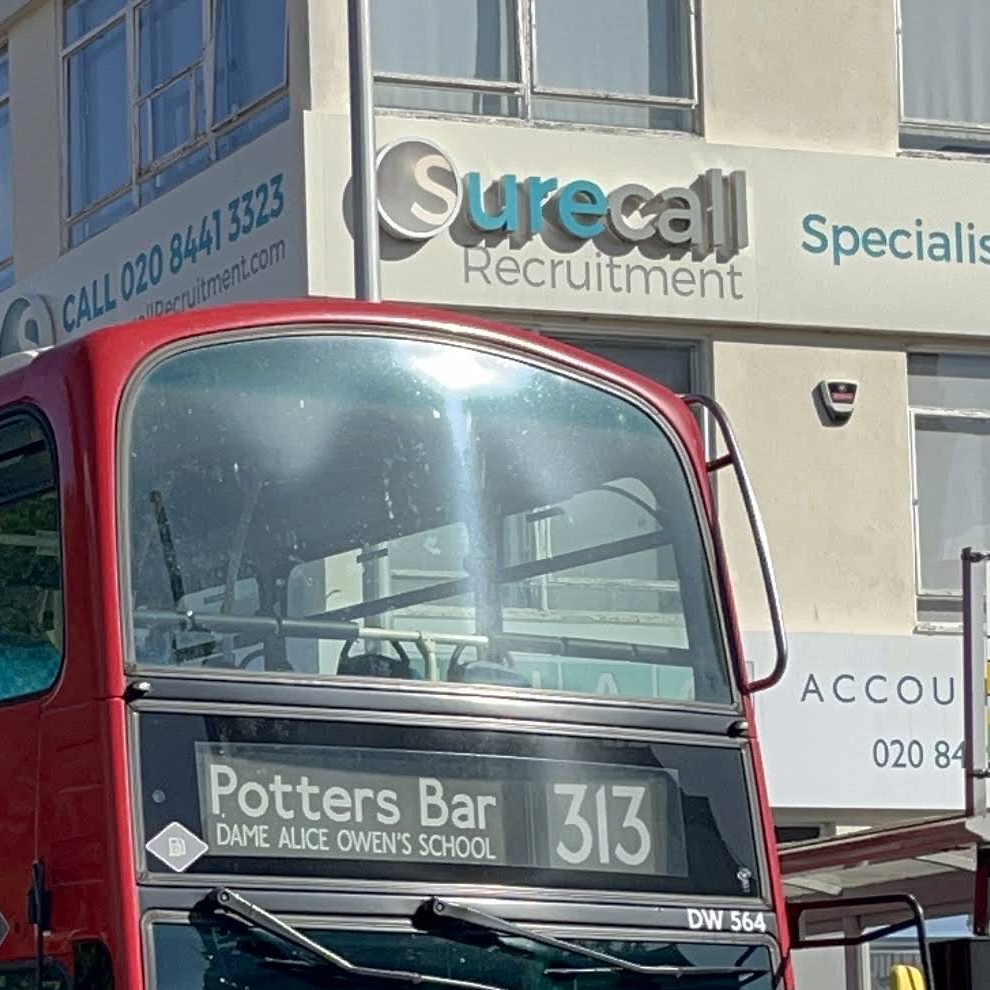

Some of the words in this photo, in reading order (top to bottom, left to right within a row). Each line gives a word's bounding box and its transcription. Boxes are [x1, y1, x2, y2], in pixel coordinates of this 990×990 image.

[411, 154, 749, 248] Surecall
[63, 273, 116, 333] CALL
[121, 244, 164, 301] 020
[169, 208, 221, 275] 8441
[227, 172, 284, 242] 3323
[463, 245, 744, 300] Recruitment
[800, 673, 955, 706] ACCOU
[873, 739, 924, 768] 020
[934, 740, 967, 768] 84
[210, 763, 401, 827] Potters
[419, 777, 497, 830] Bar
[553, 783, 650, 866] 313
[216, 823, 271, 848] DAME
[278, 826, 330, 851] ALICE
[337, 829, 412, 855] OWEN'S
[418, 833, 497, 859] SCHOOL
[687, 908, 724, 931] DW
[730, 910, 766, 933] 564
